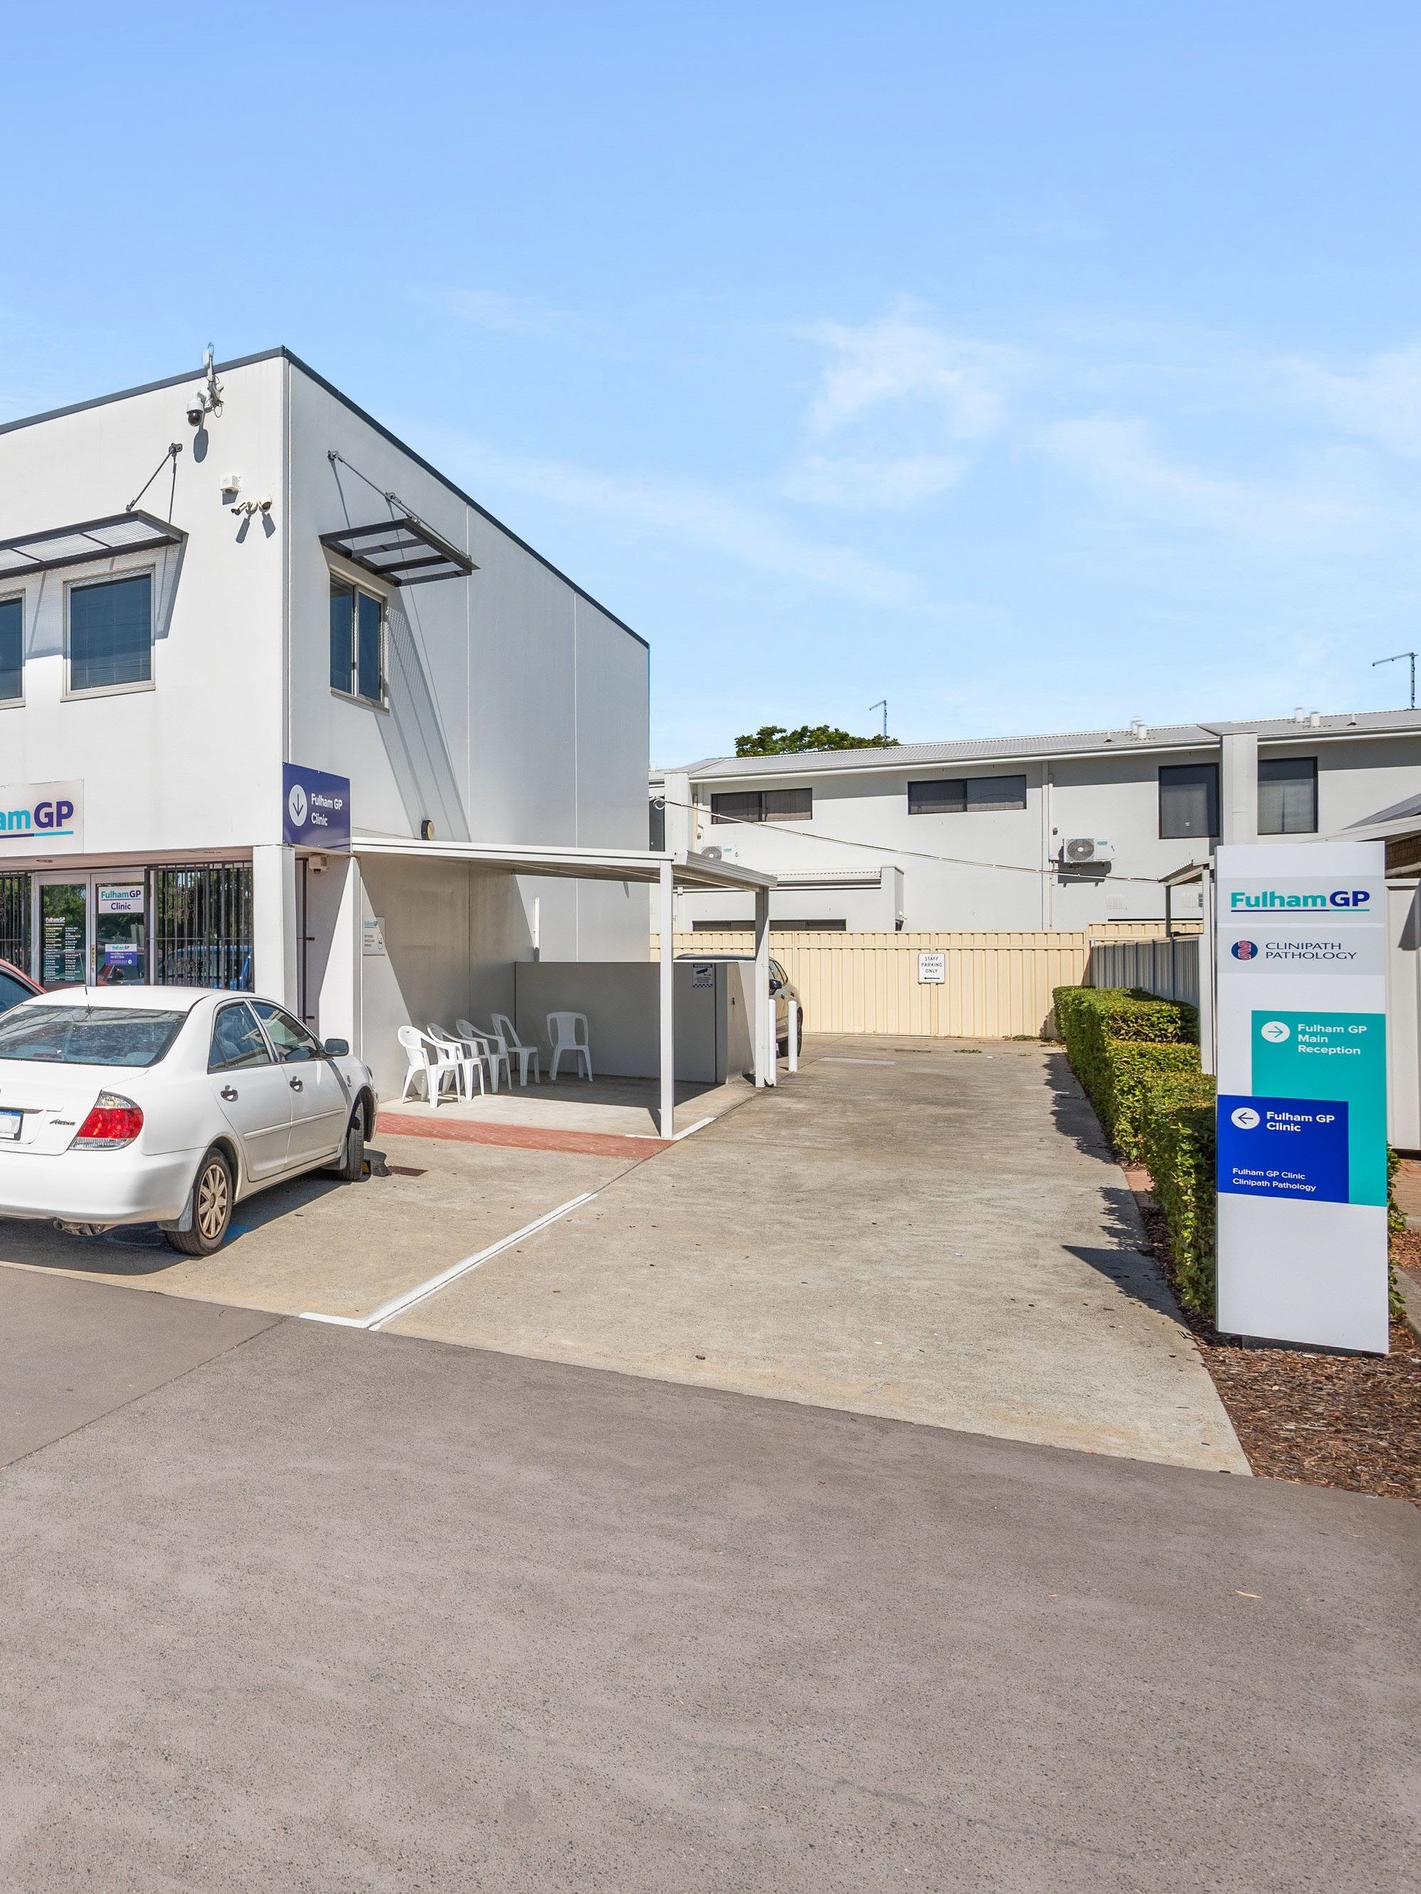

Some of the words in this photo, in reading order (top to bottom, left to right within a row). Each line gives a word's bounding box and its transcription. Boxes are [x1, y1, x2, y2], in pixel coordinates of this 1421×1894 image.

[311, 793, 333, 809] Fulham
[333, 798, 343, 810] GP
[311, 812, 328, 826] Clinic
[110, 902, 131, 911] Clinic
[1265, 942, 1342, 950] CLINIPATH
[1265, 951, 1358, 960] PATHOLOGY
[1297, 1024, 1345, 1033] Fulham
[1348, 1025, 1368, 1034] GP
[1297, 1034, 1329, 1043] Main
[1297, 1044, 1362, 1055] Reception
[1266, 1111, 1313, 1122] Fulham
[1316, 1114, 1336, 1123] GP
[1266, 1122, 1302, 1132] Clinic
[1232, 1167, 1265, 1177] Fulham
[1281, 1171, 1306, 1180] Clinic
[1232, 1178, 1271, 1187] Clinipath
[1272, 1180, 1317, 1192] Pathology
